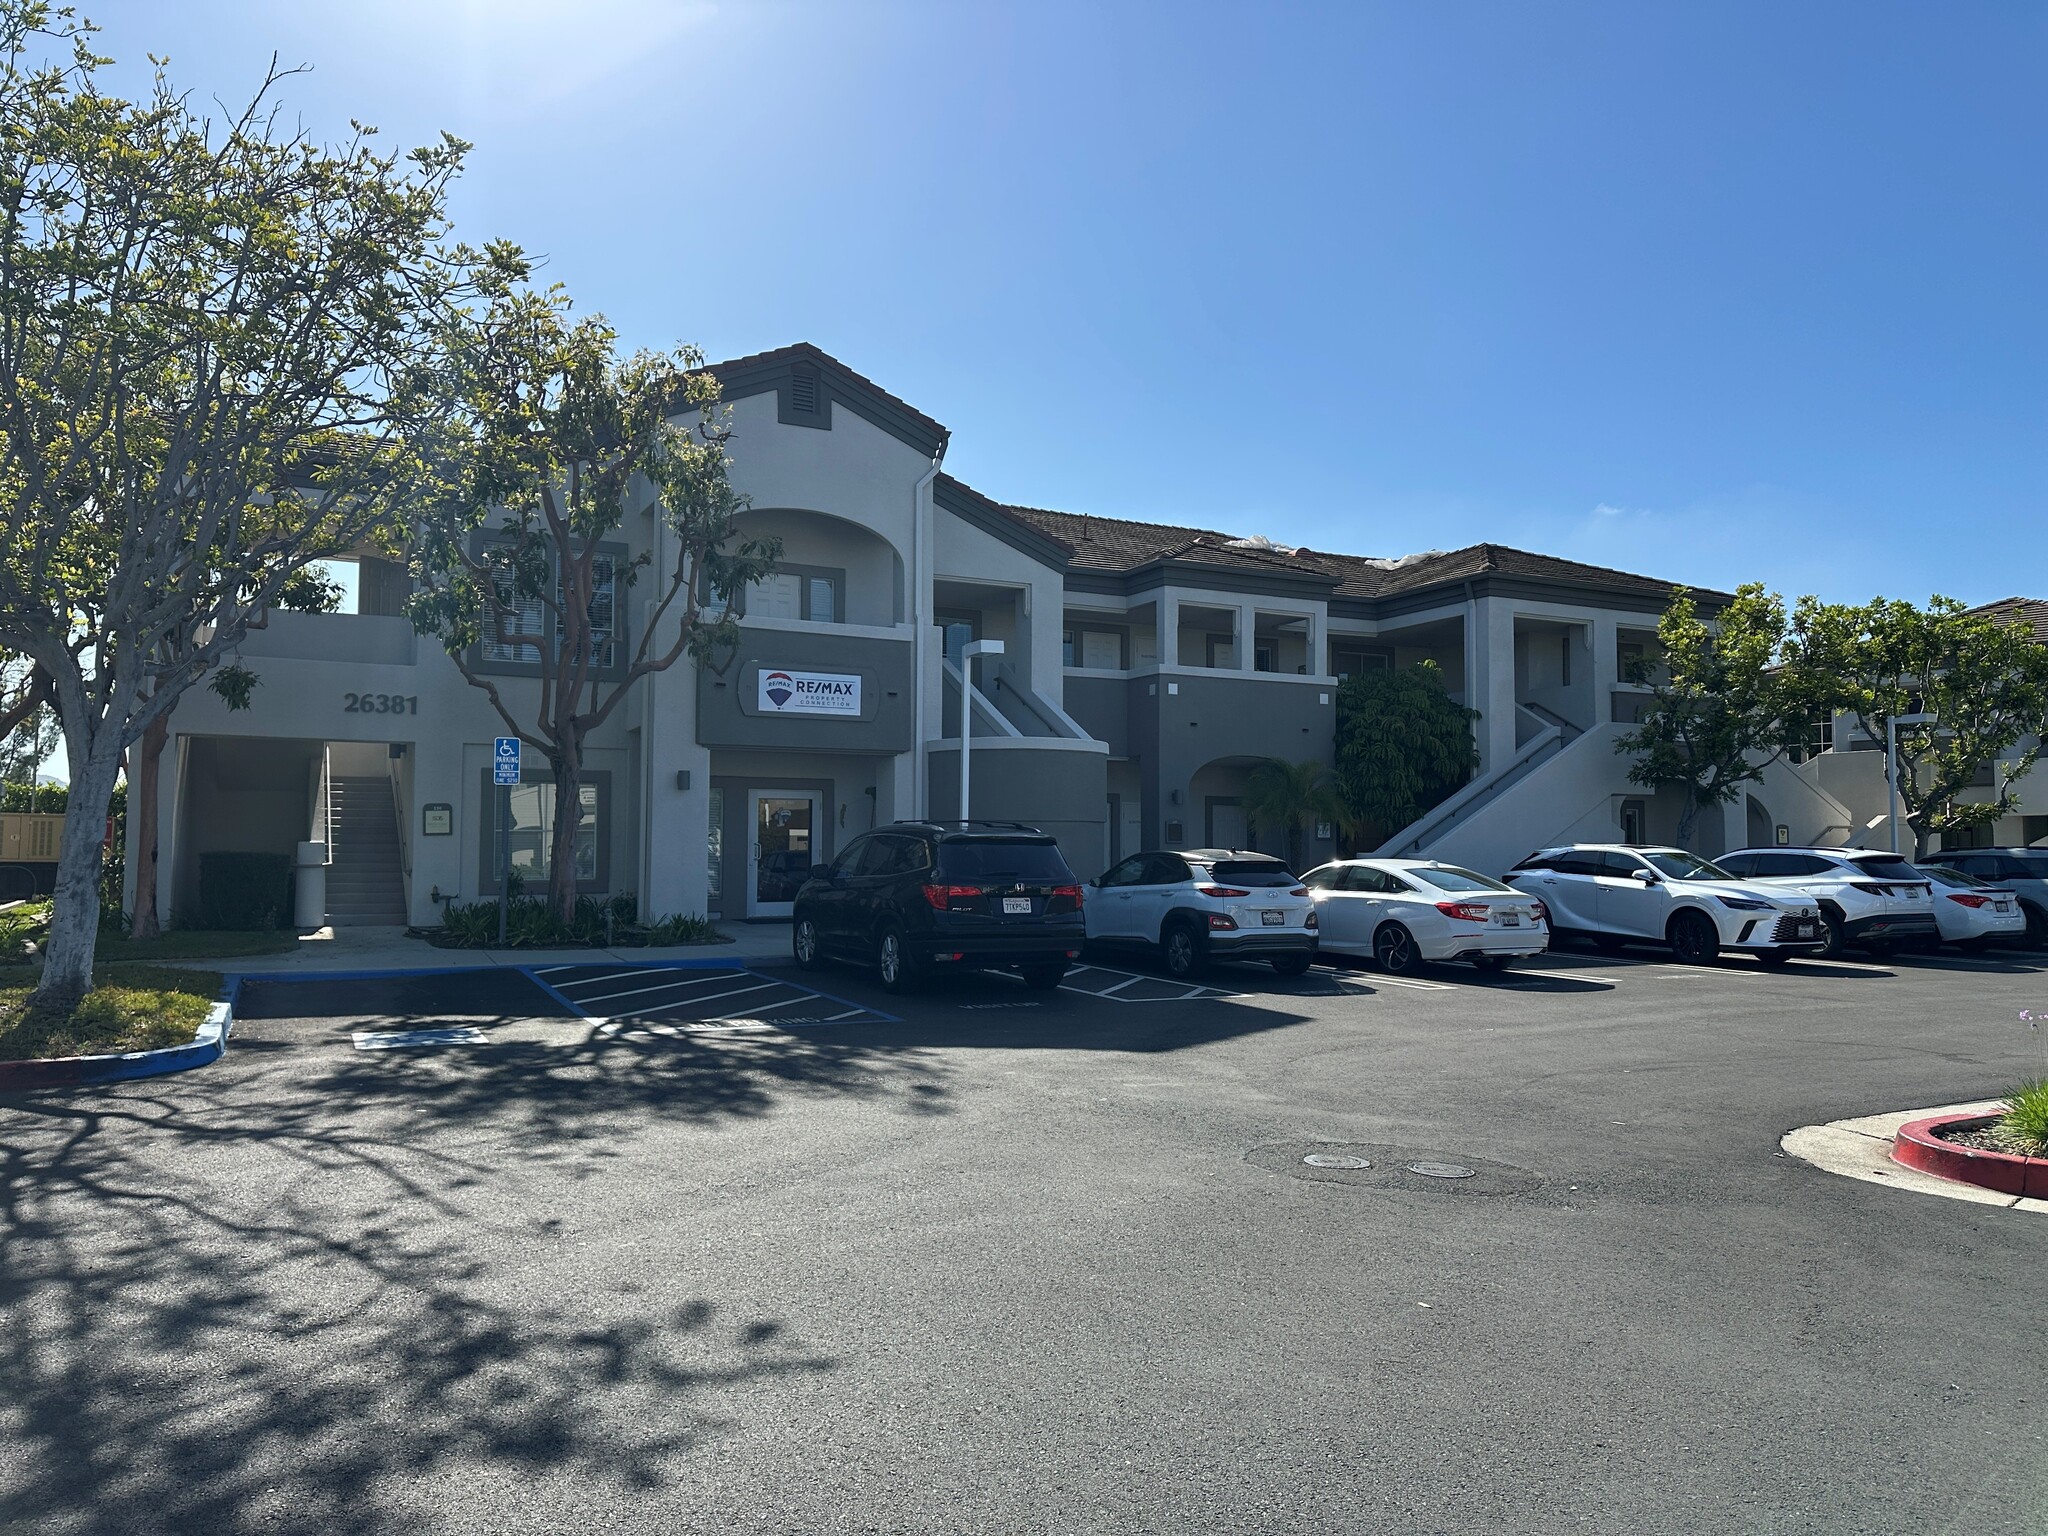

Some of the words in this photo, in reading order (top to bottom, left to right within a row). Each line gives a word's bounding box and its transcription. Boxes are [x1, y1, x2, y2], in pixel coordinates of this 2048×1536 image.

[768, 680, 791, 688] RE/MAX
[796, 681, 853, 695] RE/MAX
[344, 693, 418, 715] 26381
[496, 756, 518, 764] PARKING
[500, 763, 515, 771] ONLY
[1005, 903, 1029, 912] 7TKP540
